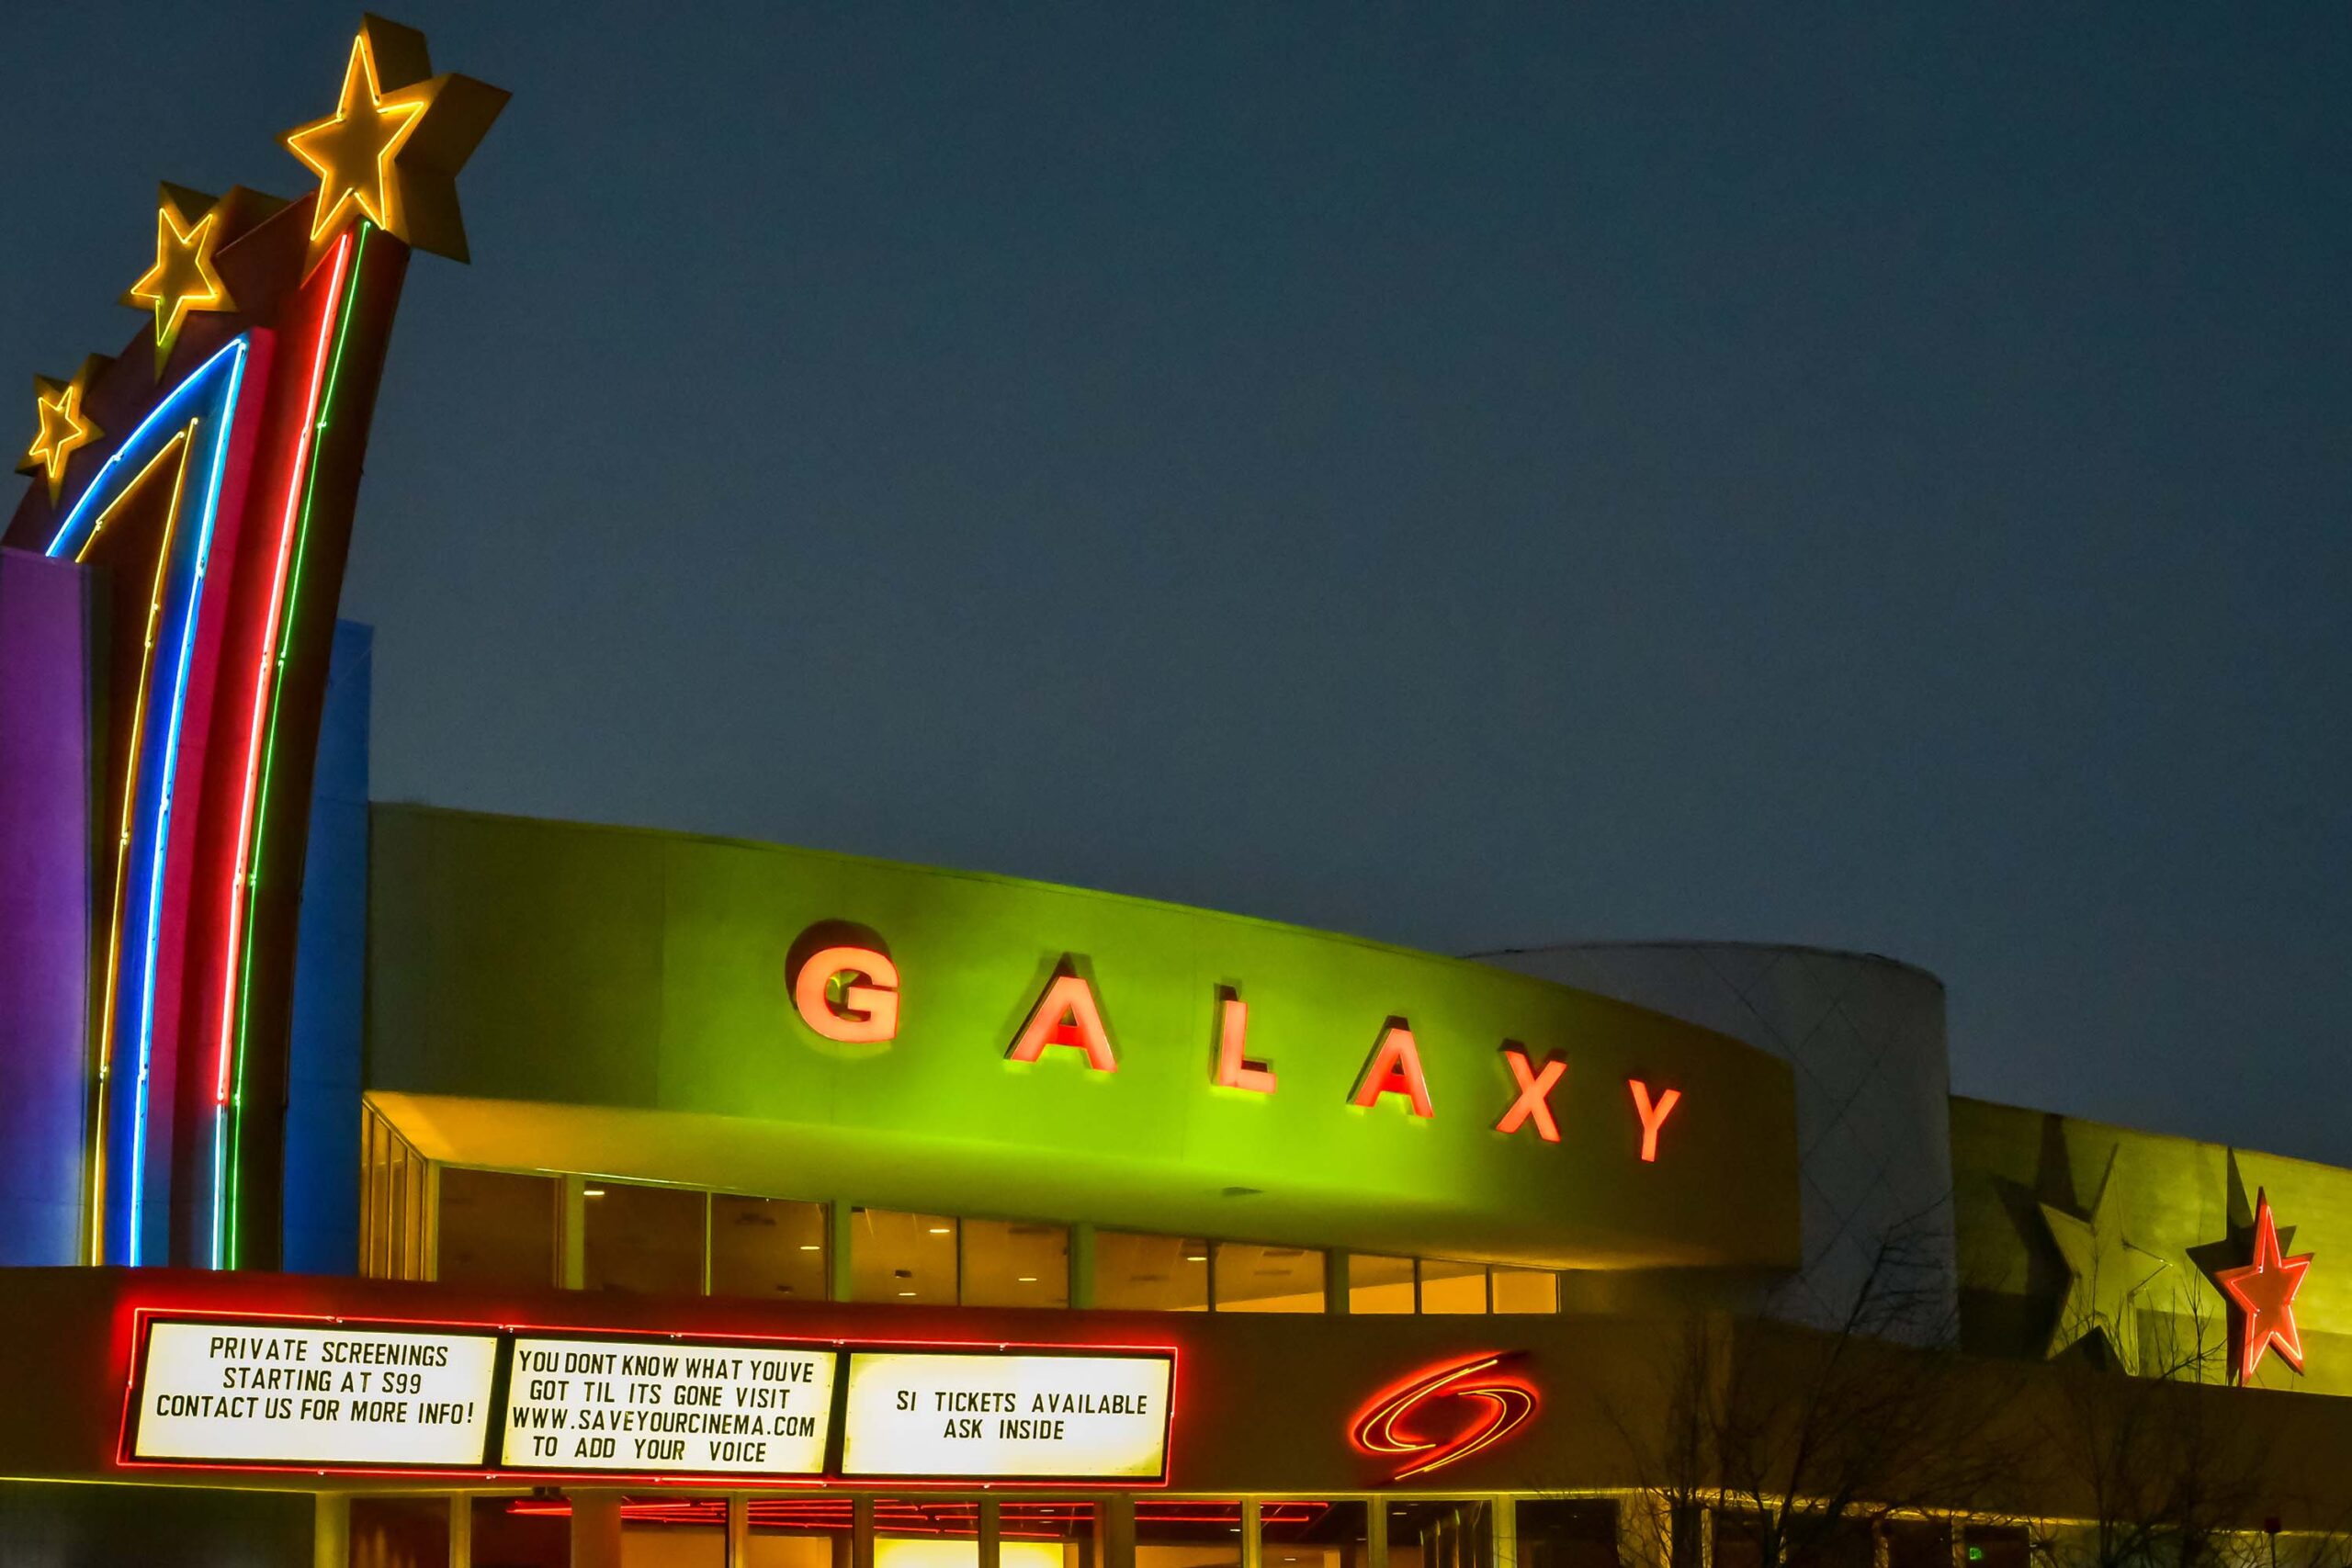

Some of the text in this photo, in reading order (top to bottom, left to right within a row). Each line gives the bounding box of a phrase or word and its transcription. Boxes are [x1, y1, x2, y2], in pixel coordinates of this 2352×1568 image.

[795, 945, 1681, 1163] GALAXY
[209, 1337, 448, 1367] PRIVATE SCREENINGS
[518, 1349, 814, 1383] YOU DONT KNOW WHAT YOUVE
[222, 1367, 332, 1392] STARTING
[340, 1371, 372, 1393] AT
[529, 1379, 791, 1409] GOT TIL ITS GONE VISIT
[156, 1394, 474, 1425] CONTACT US FOR MORE INFO!
[934, 1392, 1016, 1413] TICKETS
[1031, 1393, 1148, 1415] AVAILABLE
[513, 1406, 816, 1438] WWW.SAVEYOURCINEMA.COM
[943, 1418, 1065, 1440] ASK INSIDE
[533, 1435, 767, 1462] TO ADD YOUR VOICE
